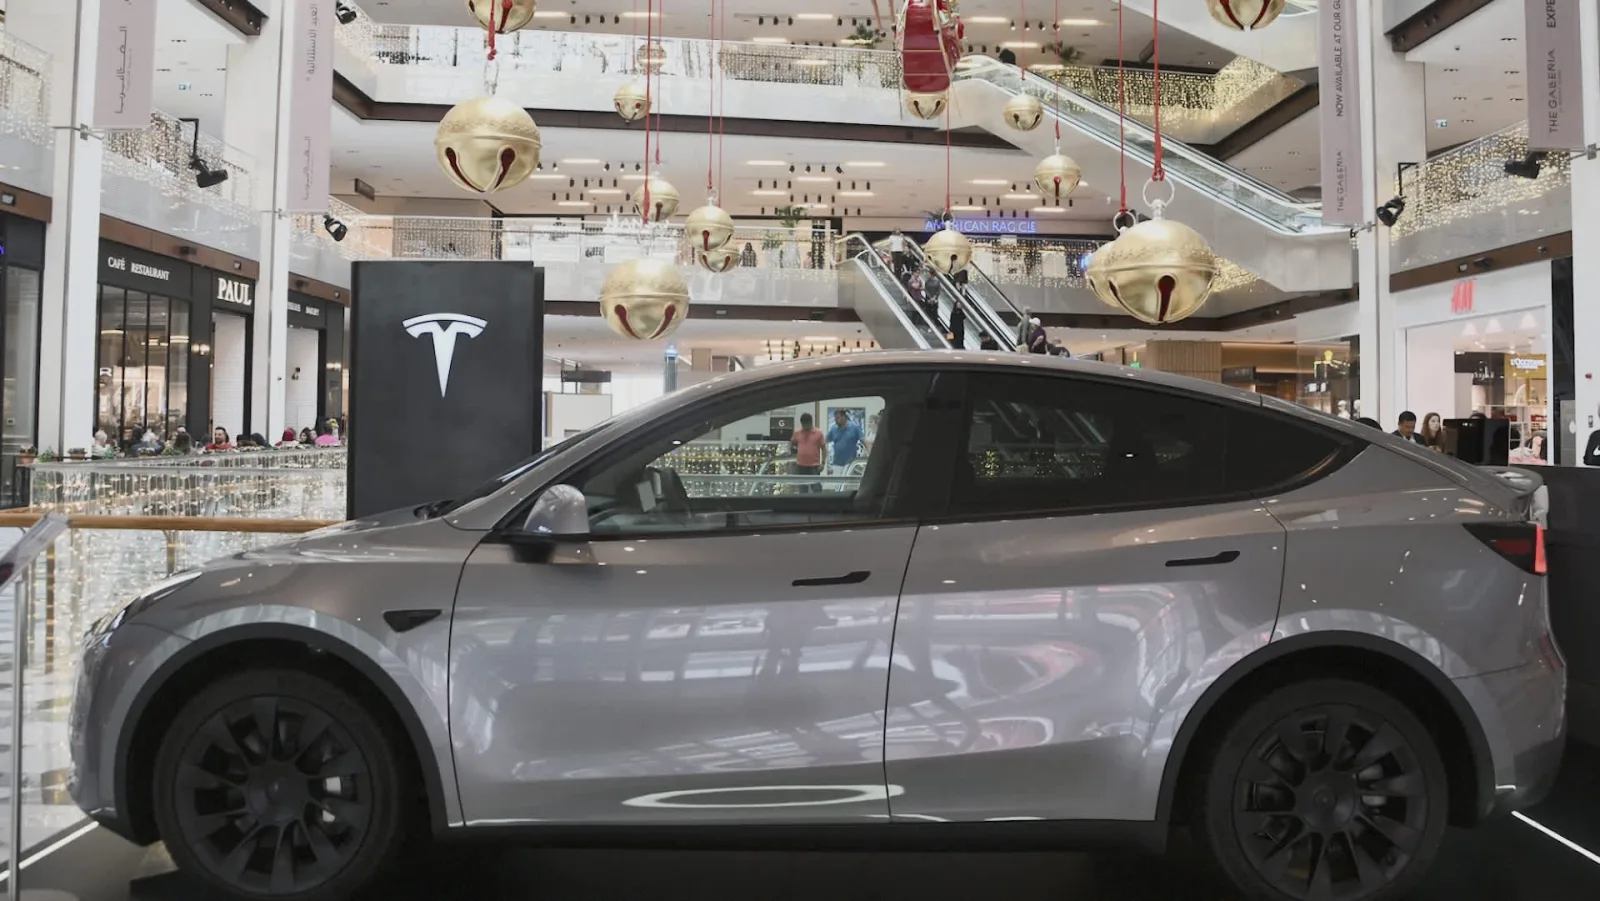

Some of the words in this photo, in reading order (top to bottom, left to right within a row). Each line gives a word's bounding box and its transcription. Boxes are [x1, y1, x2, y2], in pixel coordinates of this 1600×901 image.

[1333, 12, 1341, 31] OUR
[1333, 33, 1341, 44] AT
[1334, 46, 1343, 92] AVAILABLE
[1335, 94, 1344, 117] NOW
[1548, 111, 1558, 134] THE
[1336, 195, 1344, 212] THE
[925, 220, 988, 232] AMRICAN
[992, 220, 1015, 233] RAG
[107, 256, 126, 270] CAFÉ
[130, 262, 170, 280] RESTAURANT
[217, 277, 252, 305] PAUL
